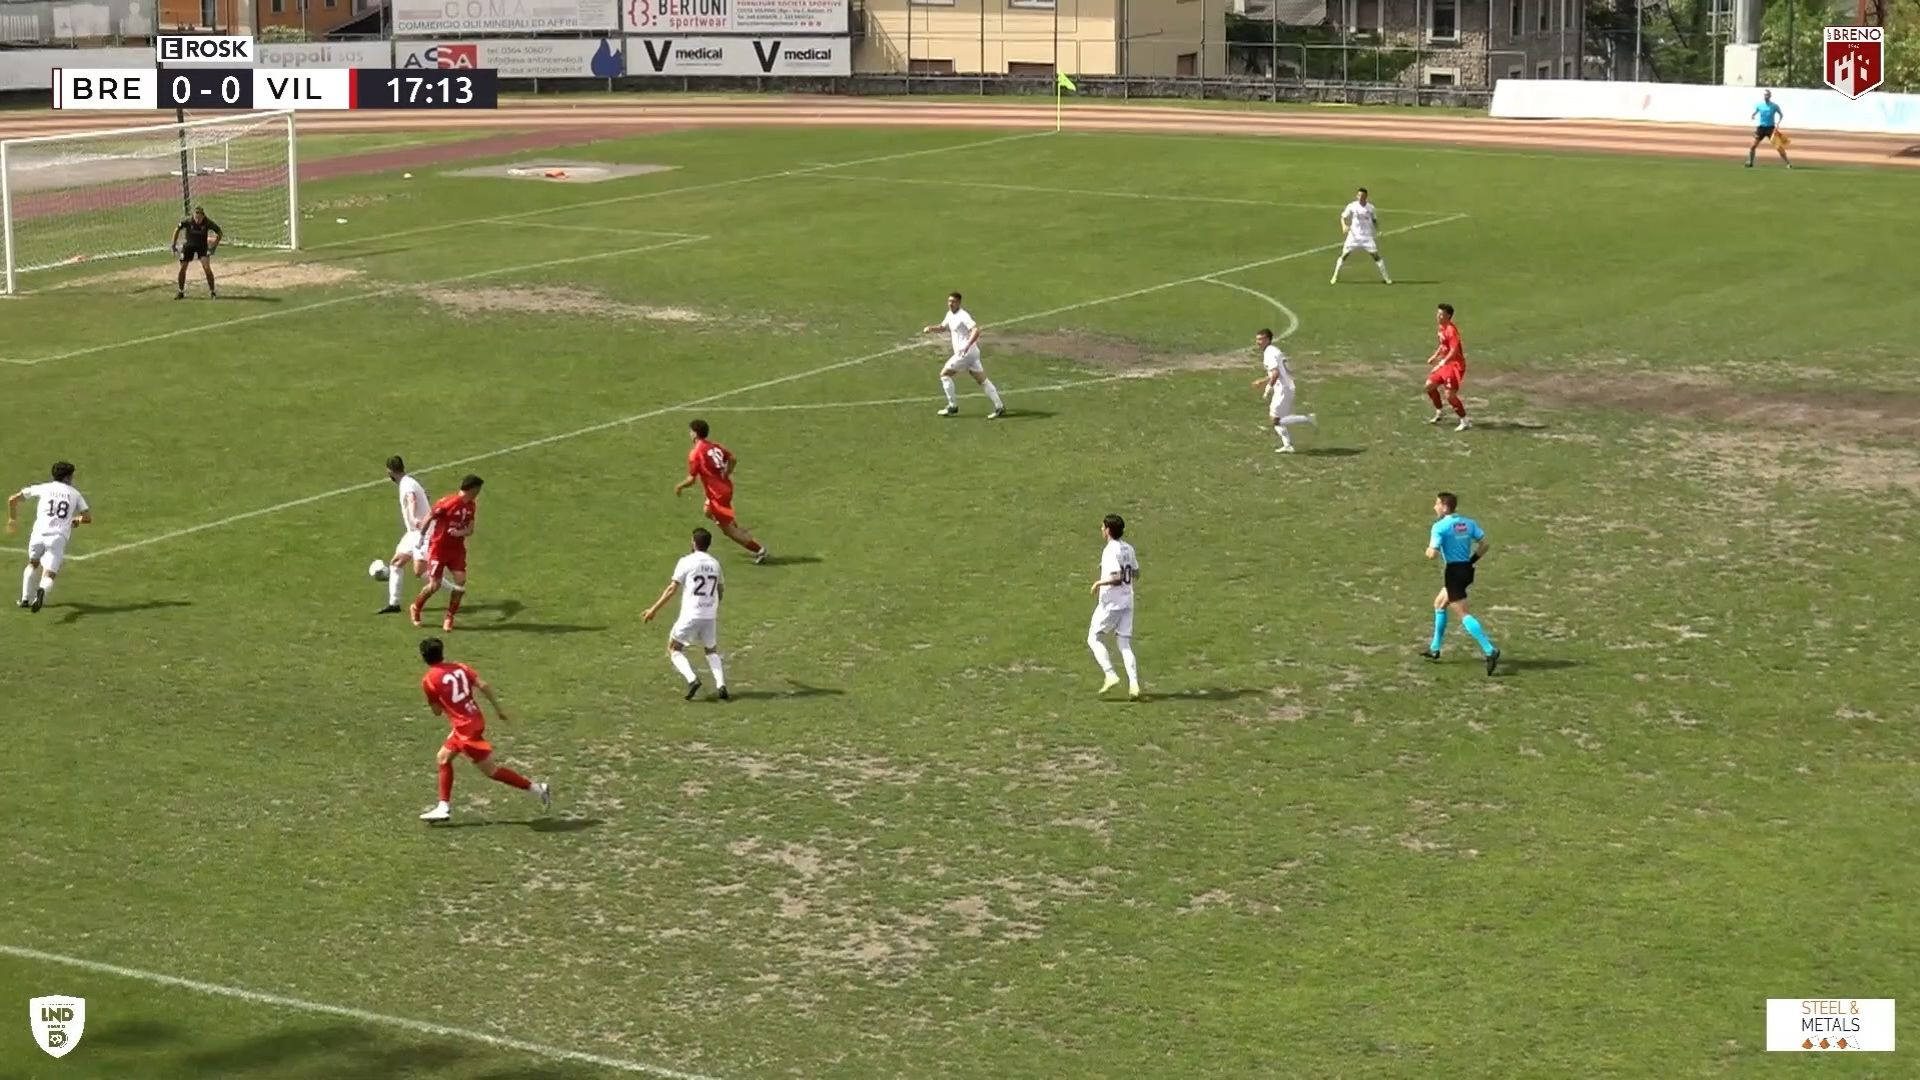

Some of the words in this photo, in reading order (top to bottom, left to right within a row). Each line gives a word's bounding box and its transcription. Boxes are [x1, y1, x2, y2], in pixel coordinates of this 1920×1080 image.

[398, 20, 460, 30] COMMERCIO
[483, 18, 529, 29] MINERALI
[669, 16, 727, 29] sportwear
[643, 40, 672, 72] V
[675, 48, 723, 60] medical
[752, 40, 782, 73] V
[784, 48, 832, 61] medical
[47, 499, 70, 519] 18
[693, 575, 718, 597] 27
[442, 668, 470, 703] 27
